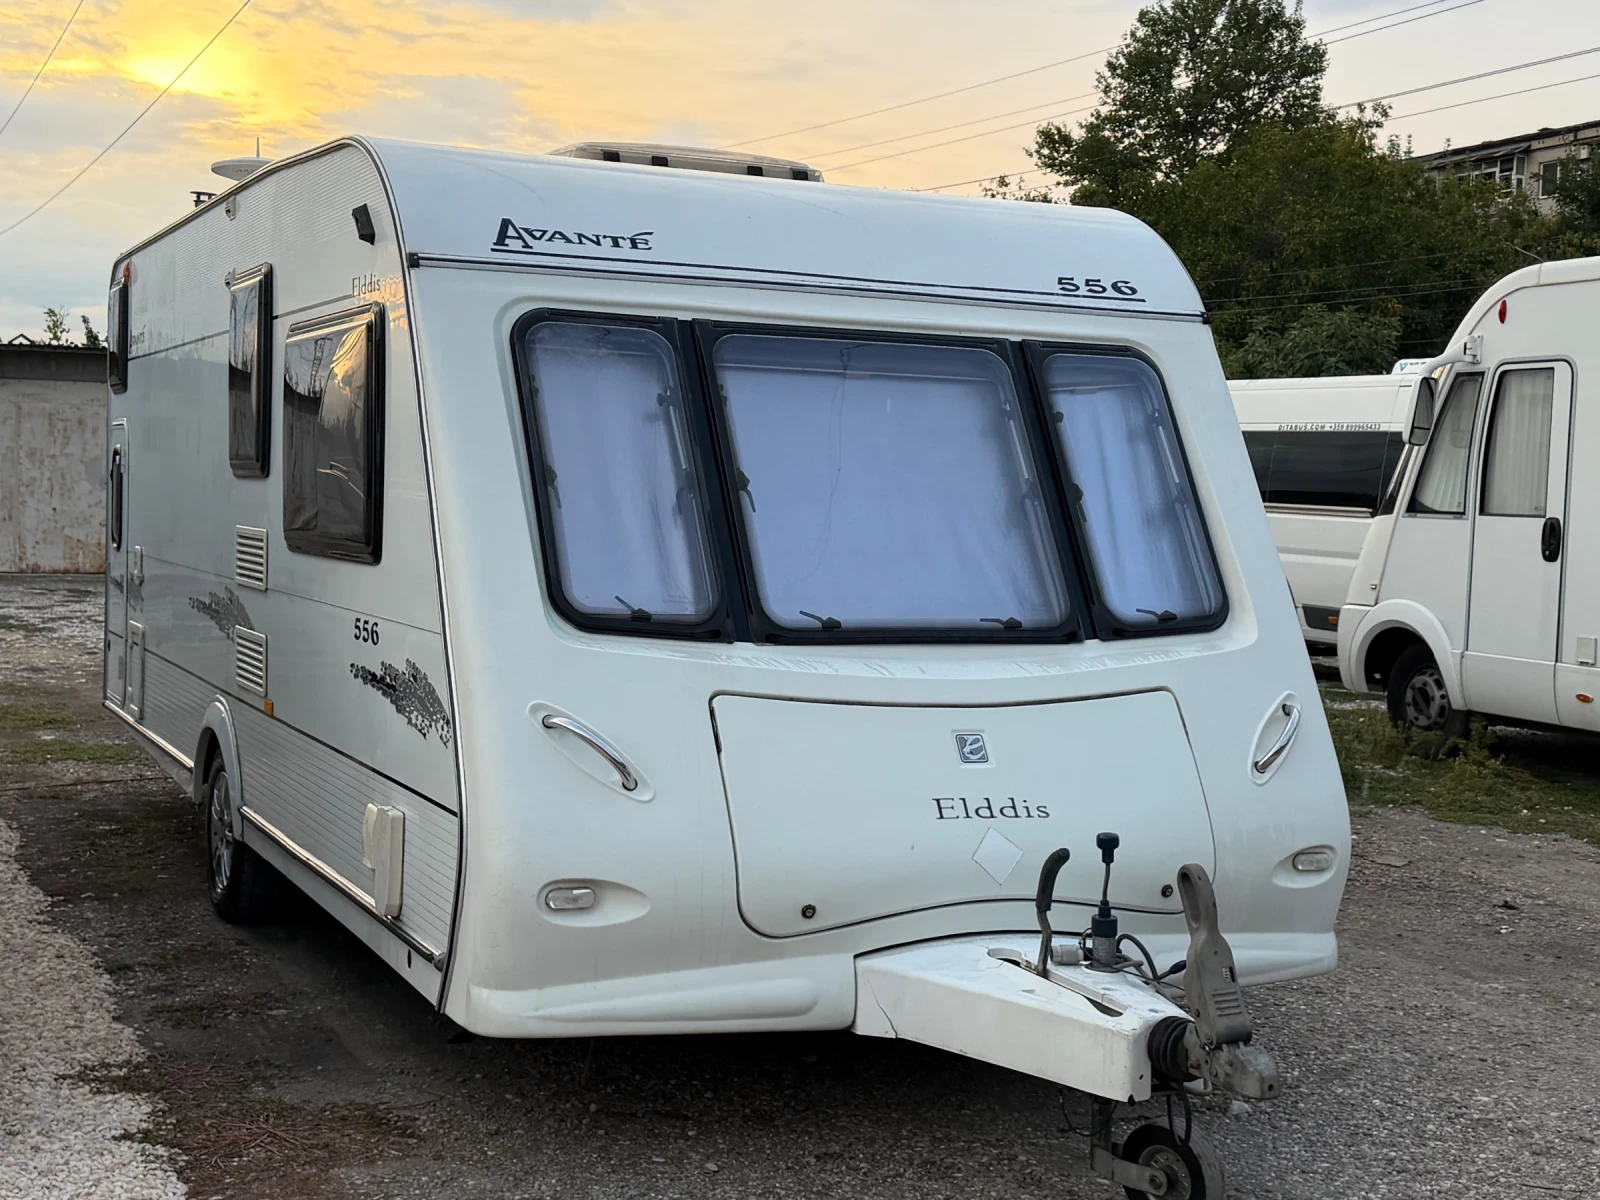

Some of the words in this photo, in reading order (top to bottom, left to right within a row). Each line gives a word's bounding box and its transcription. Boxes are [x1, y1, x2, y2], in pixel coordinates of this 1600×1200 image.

[493, 217, 655, 250] AVANTÉ
[352, 273, 381, 298] Elddis
[1057, 276, 1138, 296] 556
[354, 617, 380, 646] 556
[931, 797, 1050, 820] Elddis
